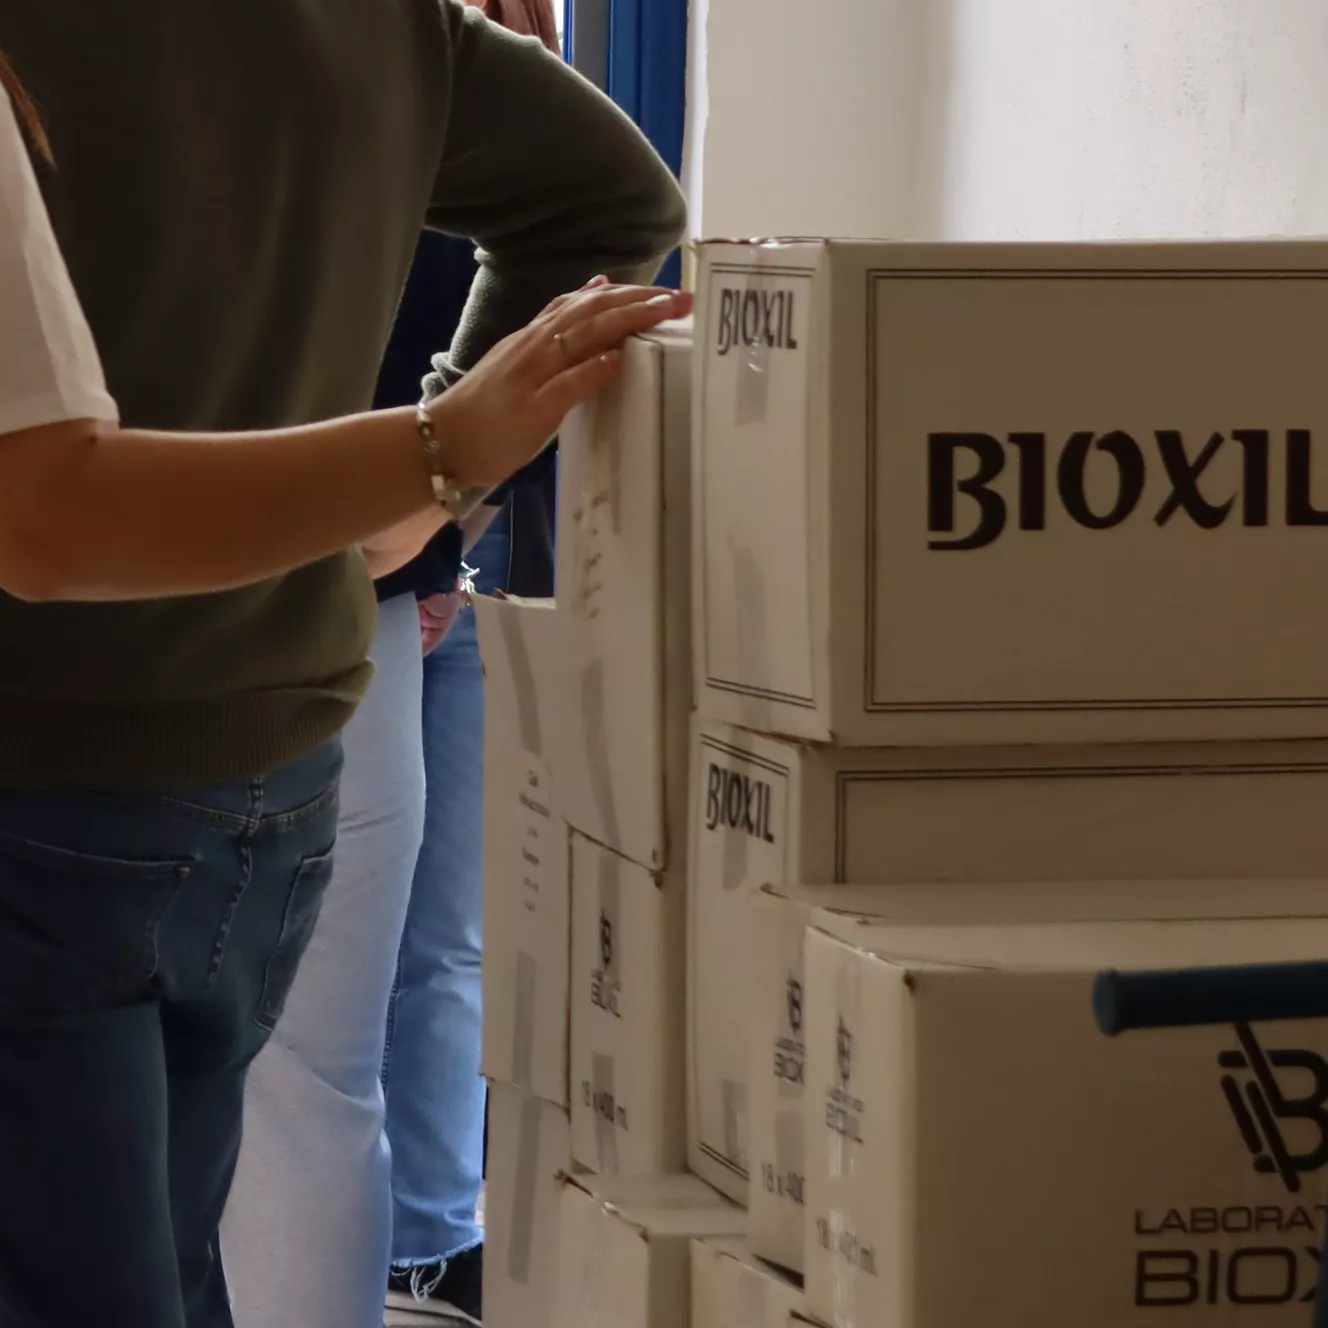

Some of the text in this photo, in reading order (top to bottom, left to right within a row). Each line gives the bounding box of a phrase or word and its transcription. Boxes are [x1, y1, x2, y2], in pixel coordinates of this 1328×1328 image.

[717, 288, 797, 356] BIOXIL
[927, 429, 1328, 551] BIOXIL
[705, 762, 774, 844] BIOXIL
